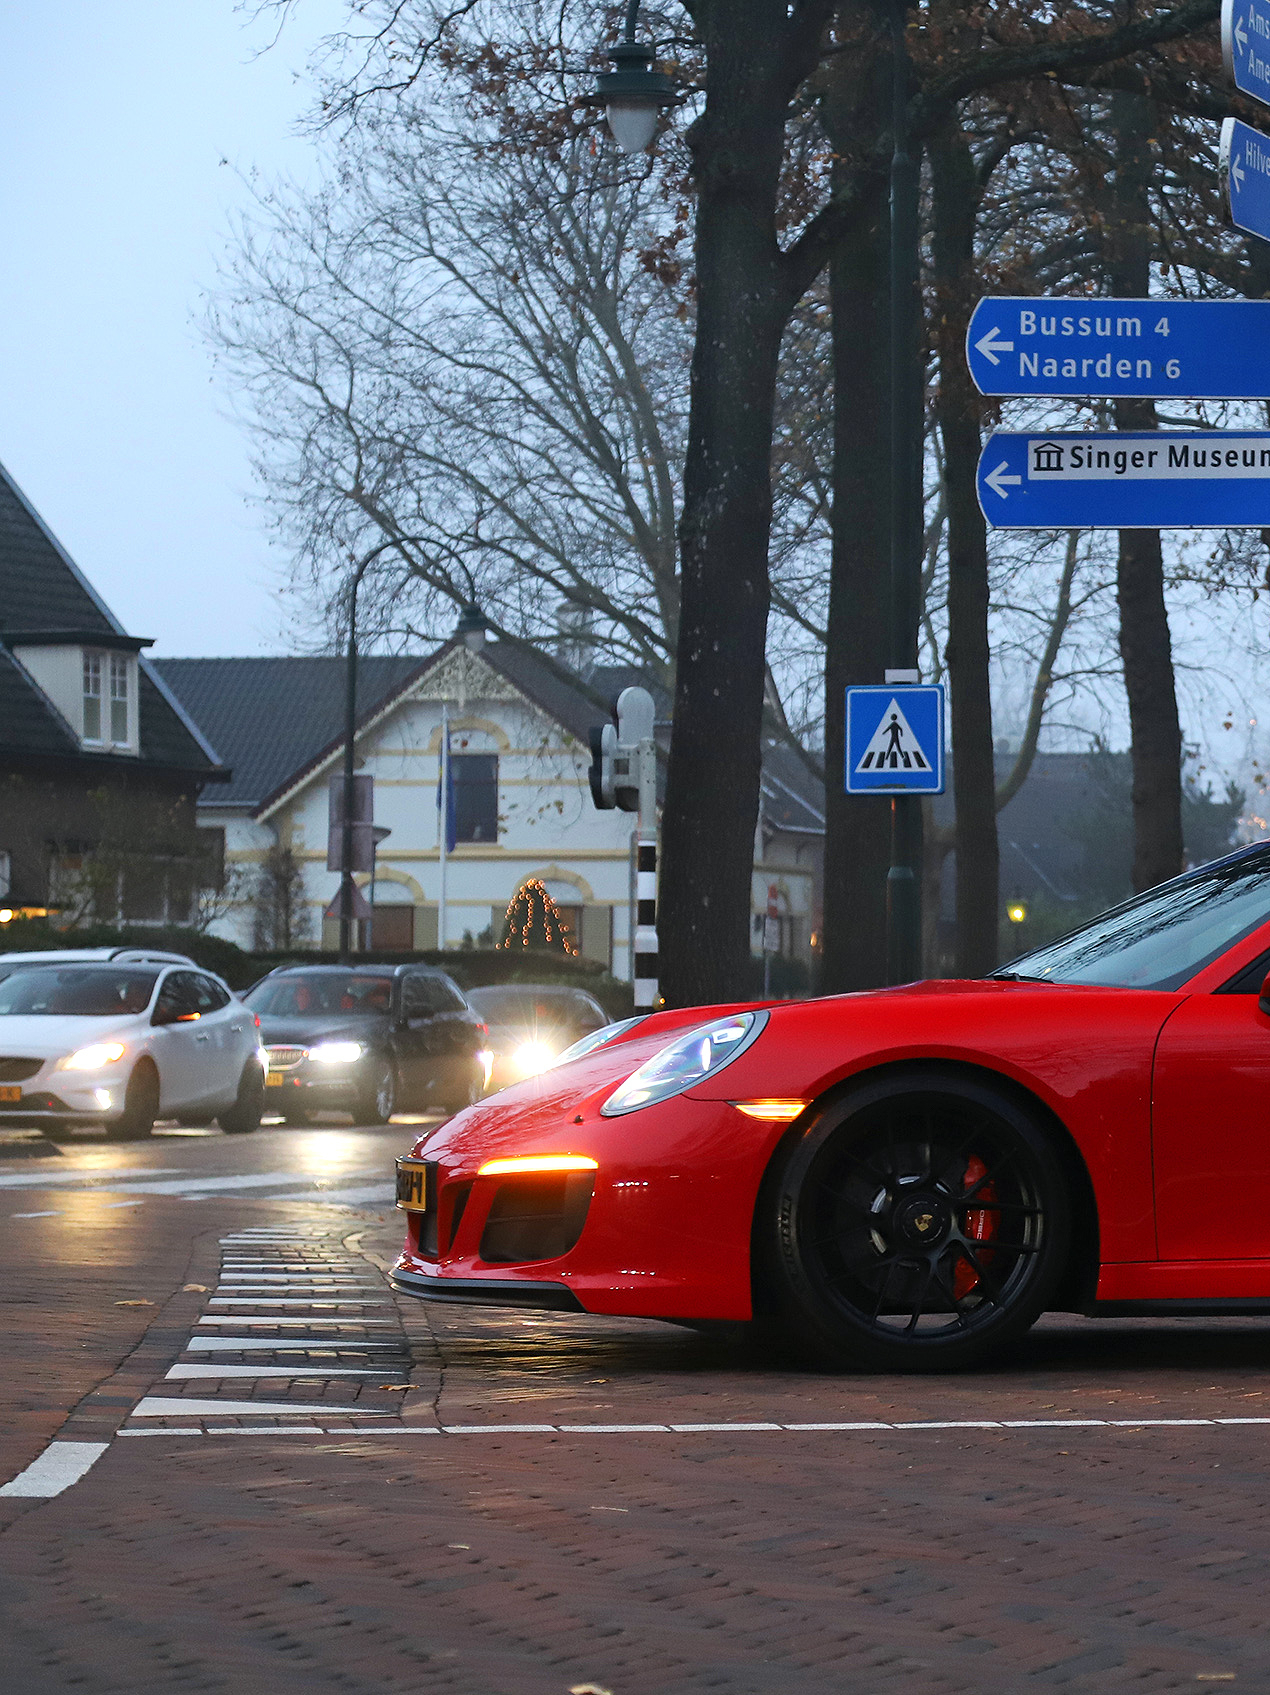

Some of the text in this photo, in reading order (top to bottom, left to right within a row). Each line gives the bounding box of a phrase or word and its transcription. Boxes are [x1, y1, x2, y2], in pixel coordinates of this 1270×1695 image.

[1019, 310, 1171, 338] Bussum 4
[1019, 352, 1181, 379] Naarden 6
[1069, 444, 1158, 475] Singer
